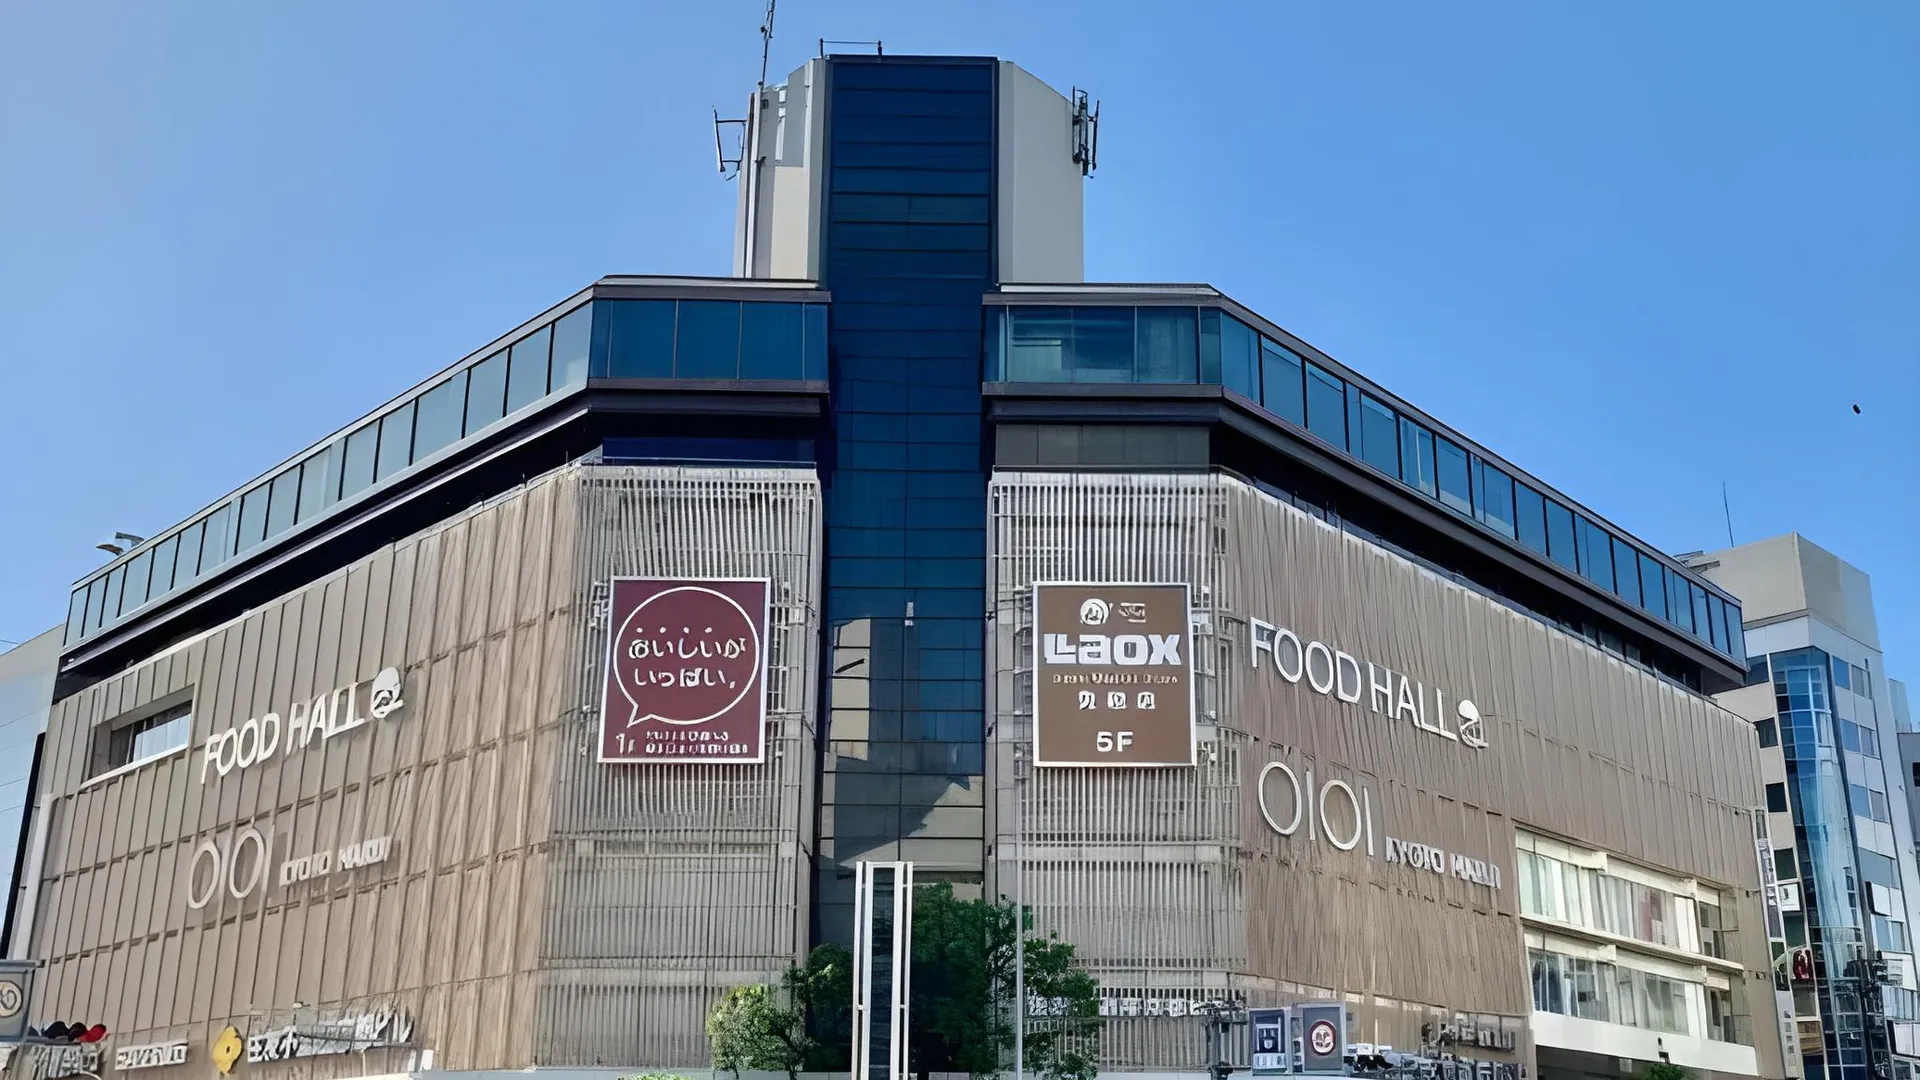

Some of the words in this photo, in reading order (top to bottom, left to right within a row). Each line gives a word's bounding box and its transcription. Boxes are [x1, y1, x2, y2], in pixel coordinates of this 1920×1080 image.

[200, 712, 281, 785] FOOD
[285, 682, 366, 756] HALL
[1250, 616, 1361, 704] FOOD
[1368, 660, 1457, 742] HALL
